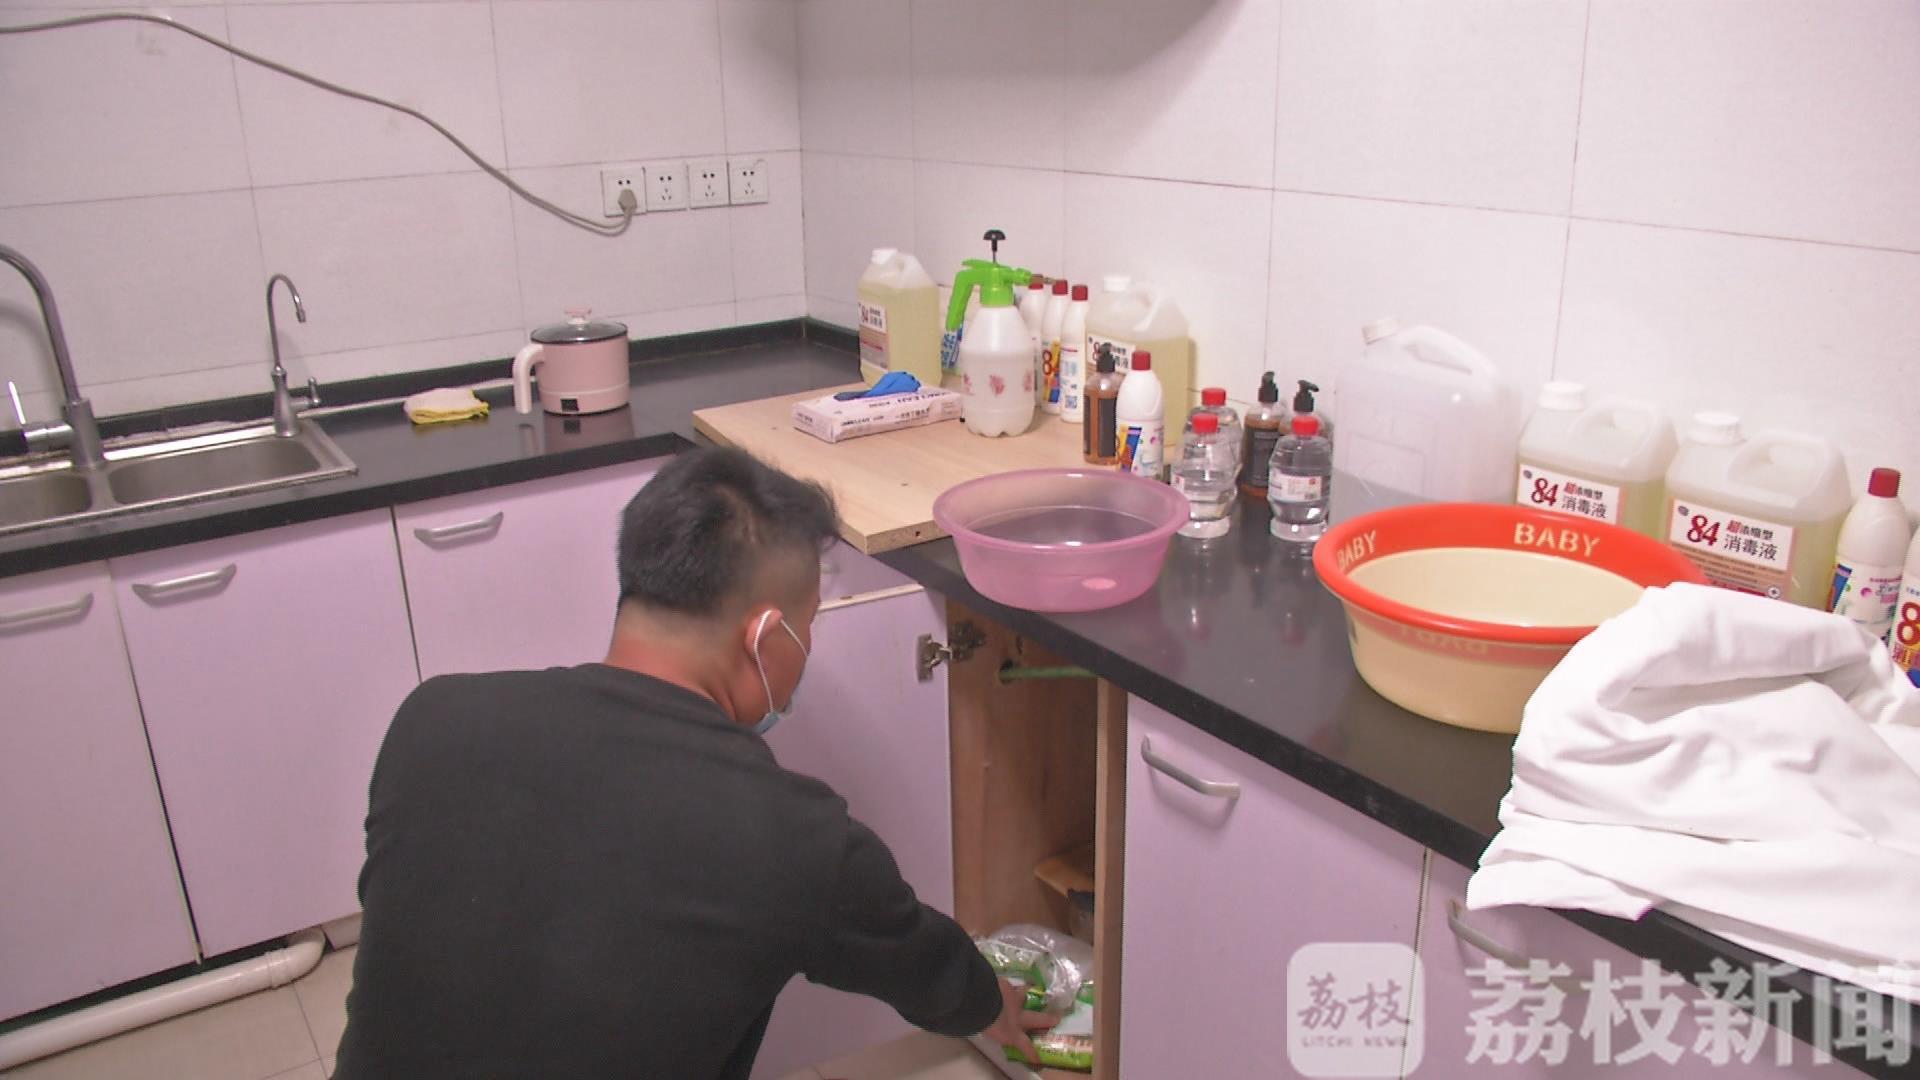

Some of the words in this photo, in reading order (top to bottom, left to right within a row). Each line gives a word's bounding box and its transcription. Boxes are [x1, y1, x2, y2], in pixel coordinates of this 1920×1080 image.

[1531, 477, 1559, 507] 84
[1561, 495, 1607, 519] 消毒液
[1514, 522, 1600, 557] BABY
[1687, 514, 1720, 546] 84
[1336, 530, 1377, 570] BABY
[1724, 533, 1778, 561] 消毒液
